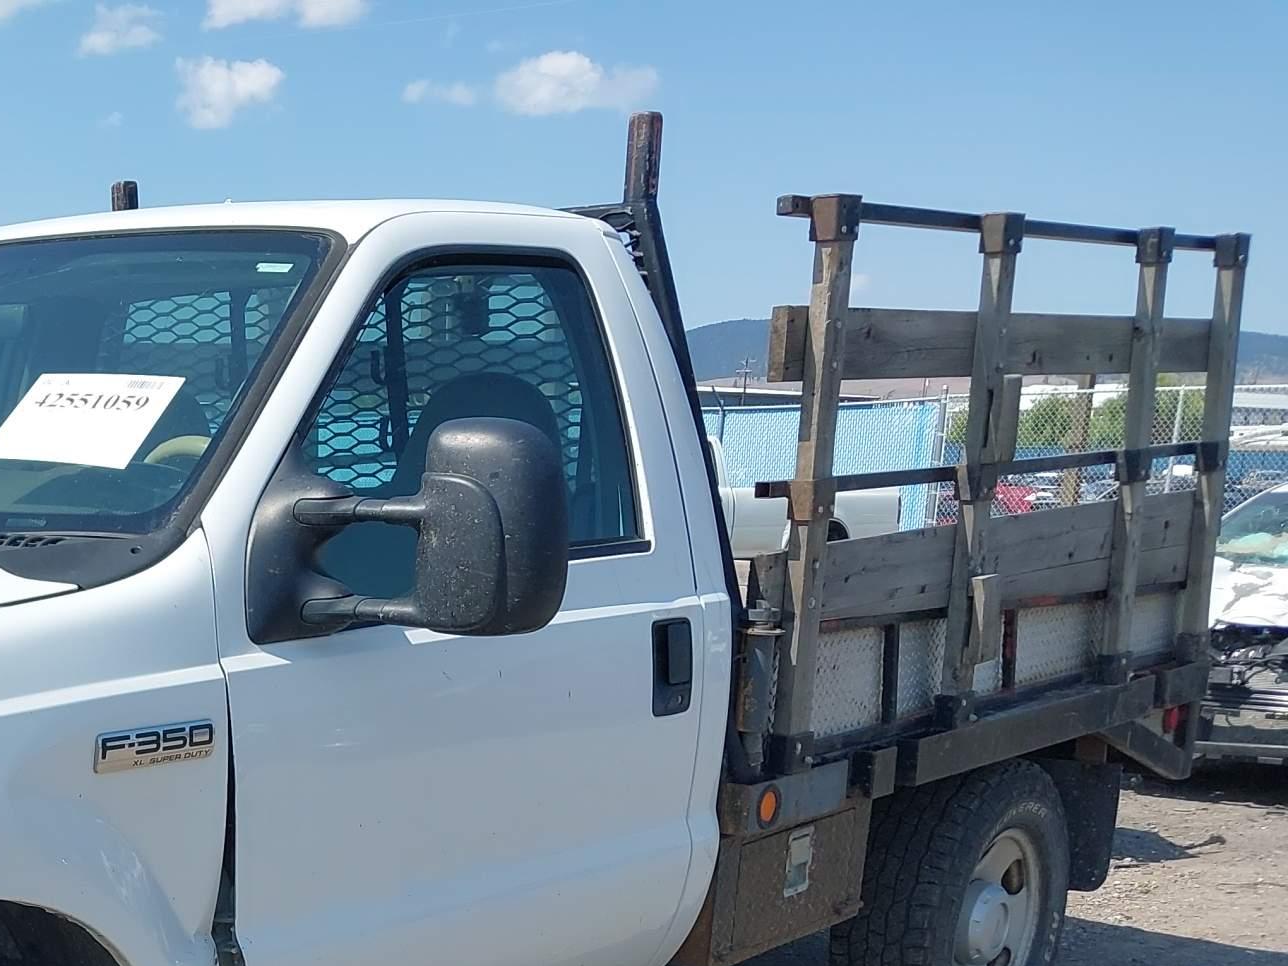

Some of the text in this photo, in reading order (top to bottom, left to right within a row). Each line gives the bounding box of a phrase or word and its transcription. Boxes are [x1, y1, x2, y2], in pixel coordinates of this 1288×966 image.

[34, 393, 150, 411] 42551059
[100, 723, 214, 760] F-350
[132, 748, 211, 767] XL SUPER DUTY
